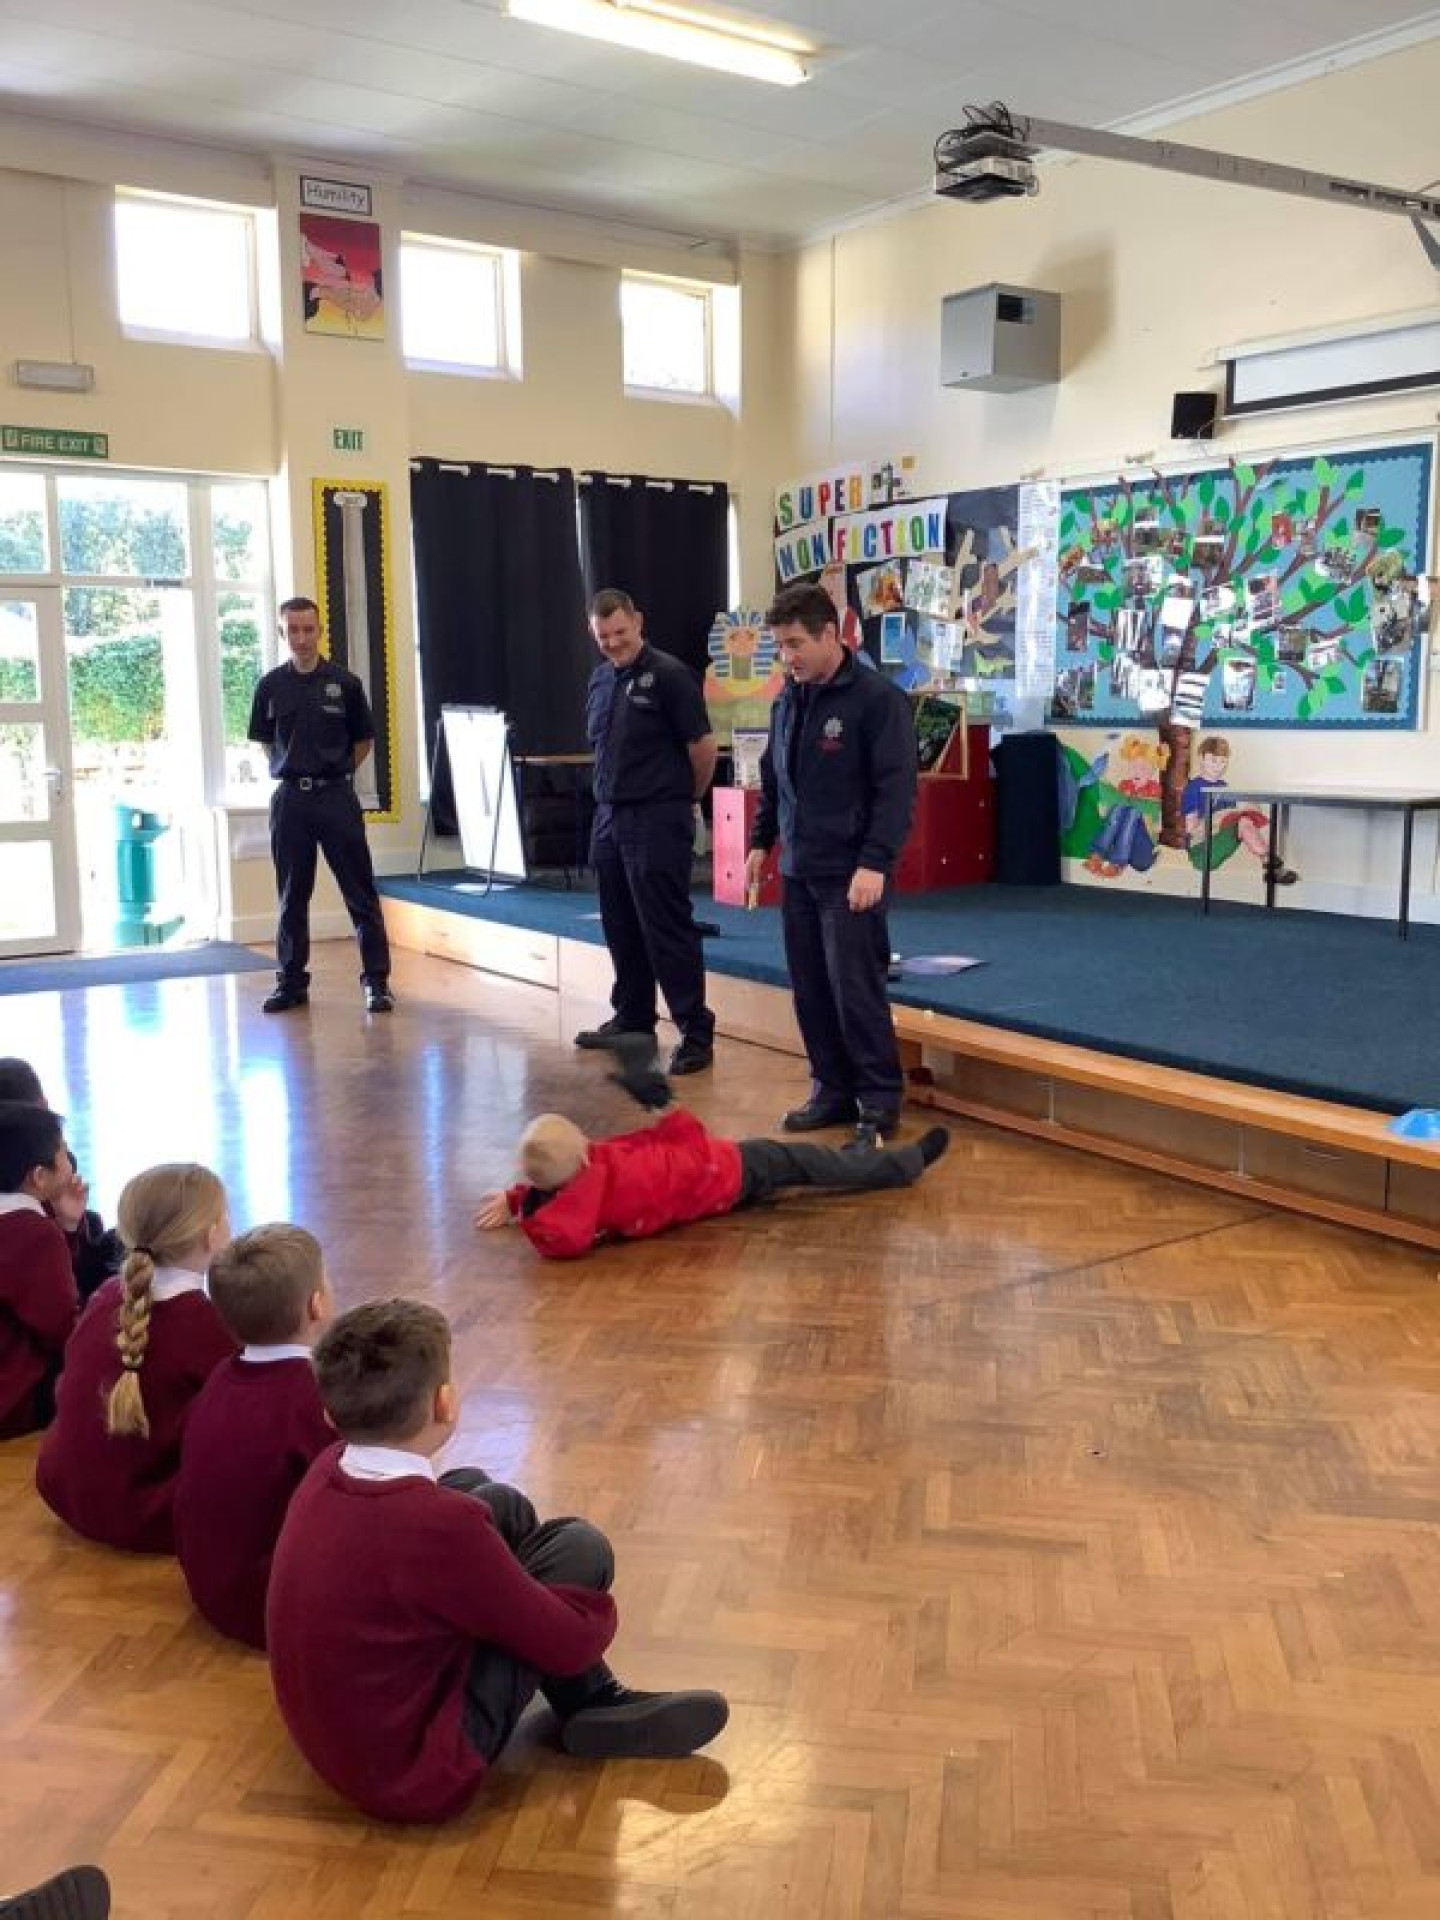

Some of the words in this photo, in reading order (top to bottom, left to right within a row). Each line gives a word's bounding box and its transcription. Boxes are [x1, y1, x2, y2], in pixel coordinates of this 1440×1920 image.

[21, 433, 55, 450] FIRE
[59, 436, 89, 452] EXIT
[336, 431, 362, 449] EXIT
[779, 475, 862, 525] SUPER
[779, 532, 827, 577] NON
[837, 512, 940, 562] FICTION
